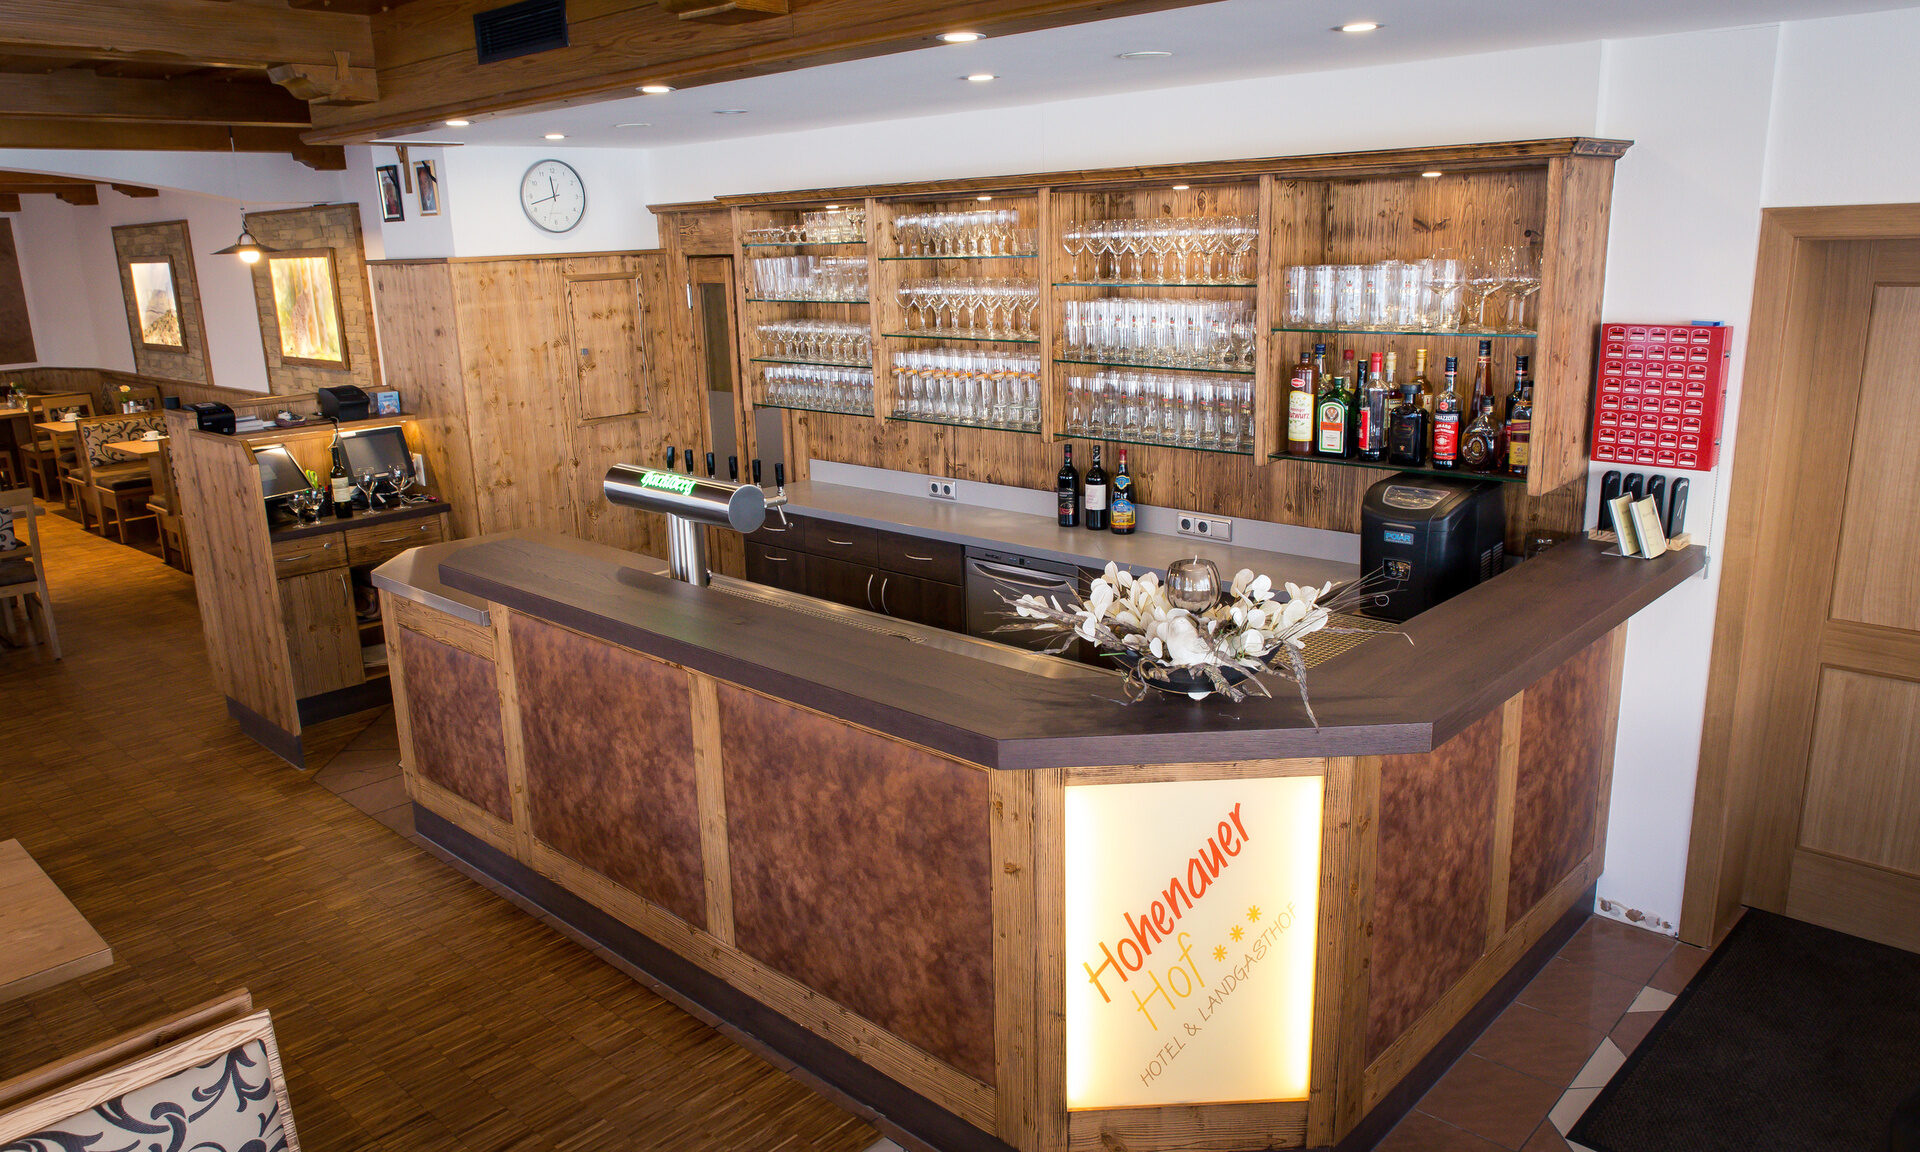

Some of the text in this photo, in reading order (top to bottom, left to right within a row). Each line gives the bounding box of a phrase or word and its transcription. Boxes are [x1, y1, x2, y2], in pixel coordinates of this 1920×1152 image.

[1386, 532, 1411, 542] POLAR
[1083, 802, 1249, 1004] Hohenauer
[1130, 931, 1206, 1031] Hof
[1139, 900, 1298, 1088] HOTEL & LANDGASTHOF
